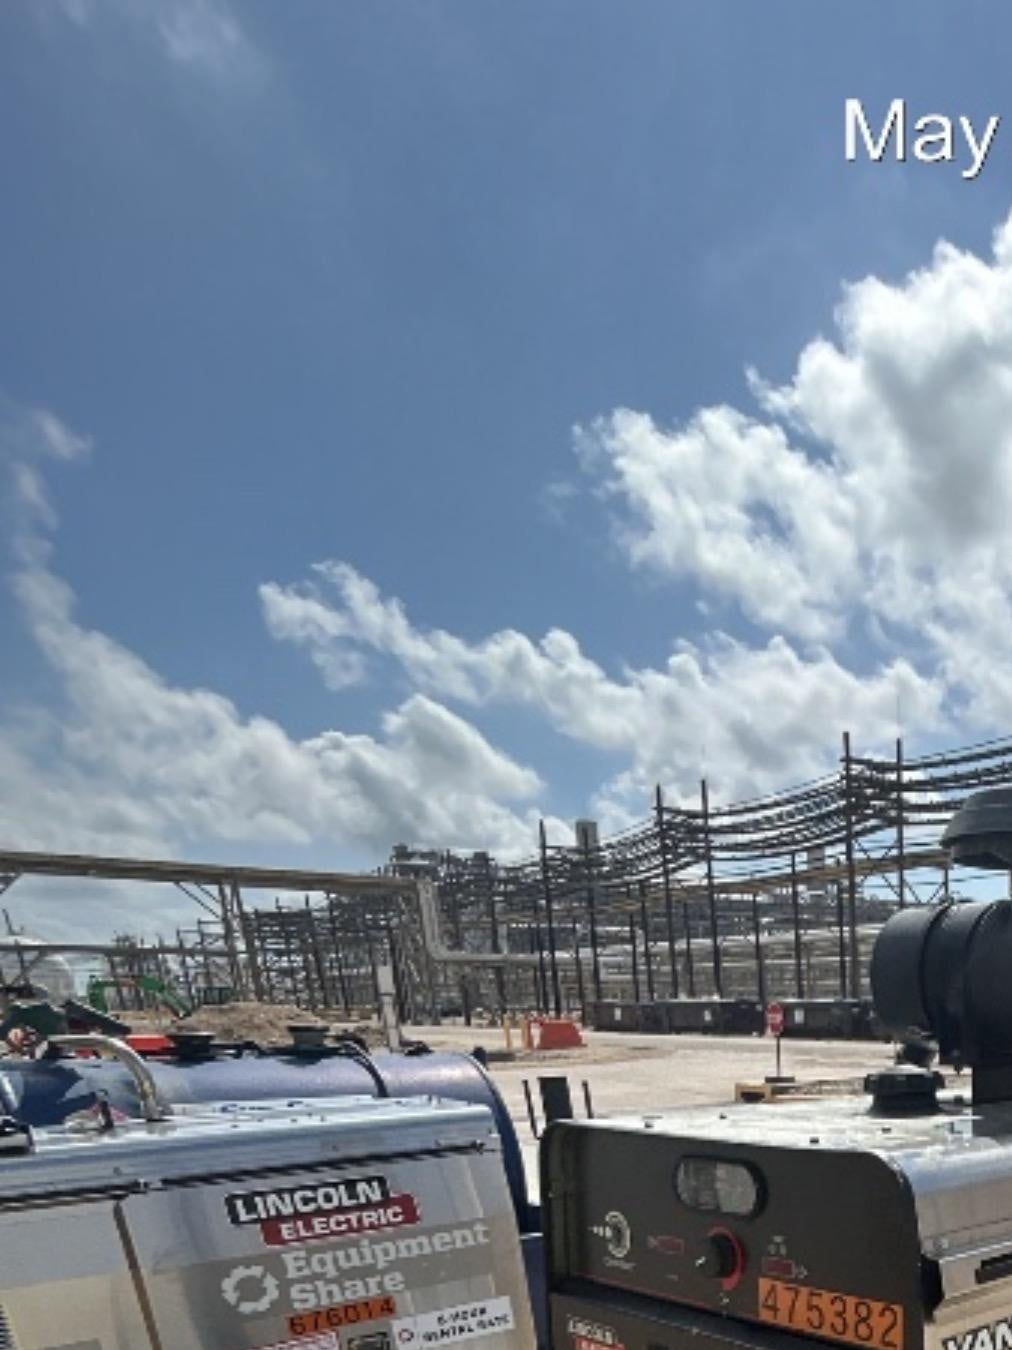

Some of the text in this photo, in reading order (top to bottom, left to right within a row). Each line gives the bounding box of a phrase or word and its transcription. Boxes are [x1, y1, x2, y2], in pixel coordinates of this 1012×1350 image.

[235, 1179, 383, 1223] LINCOLN
[280, 1205, 404, 1241] ELECTRIC
[281, 1222, 491, 1279] Equipment
[290, 1269, 405, 1310] Share
[762, 1284, 899, 1349] 475382
